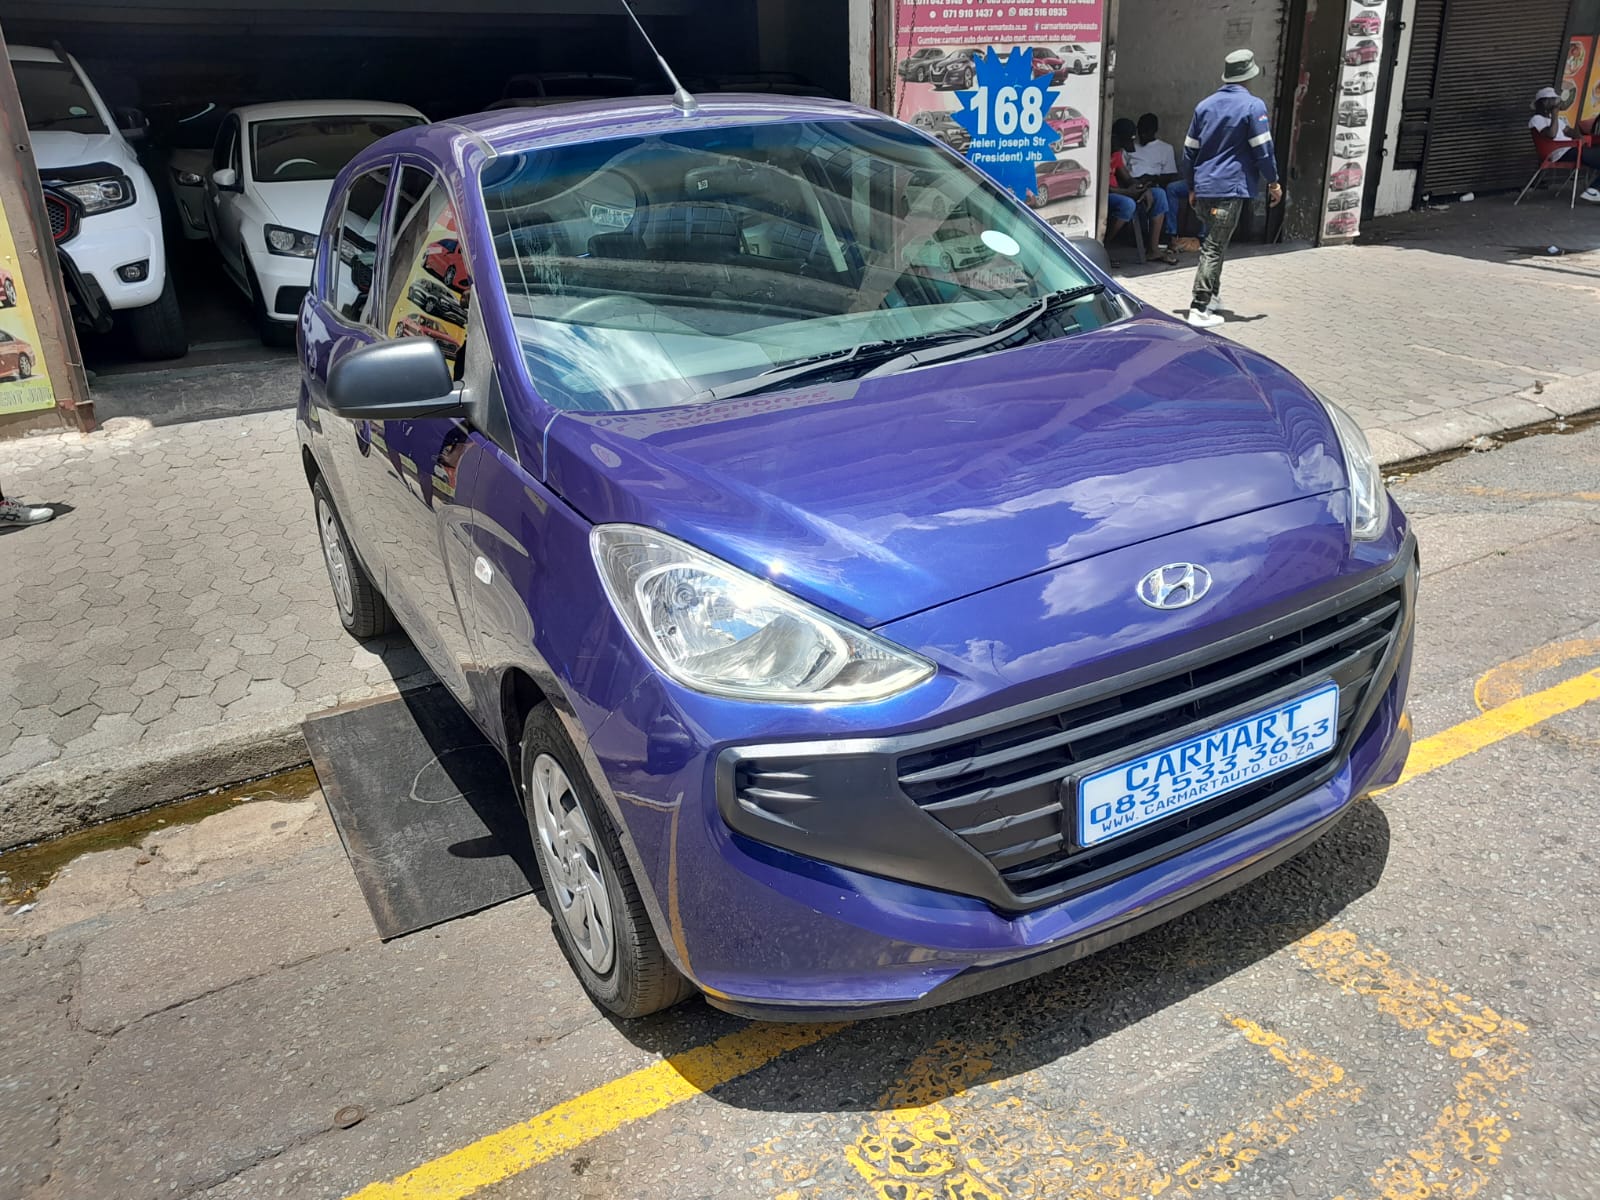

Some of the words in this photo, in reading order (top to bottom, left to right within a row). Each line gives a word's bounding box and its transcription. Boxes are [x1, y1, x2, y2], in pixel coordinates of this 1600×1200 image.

[943, 9, 957, 18] 071
[958, 9, 974, 18] 910
[975, 8, 994, 18] 1437
[1018, 8, 1033, 17] 083
[1034, 8, 1047, 16] 516
[1048, 8, 1068, 16] 0935
[970, 86, 1043, 135] 168
[970, 137, 996, 149] Helen
[998, 136, 1030, 150] joseph
[1032, 136, 1046, 146] Str
[971, 150, 1024, 163] (President)
[1026, 151, 1042, 161] Jhb
[1126, 704, 1302, 791] CARMART
[1090, 784, 1160, 825] 083
[1172, 754, 1238, 793] 533
[1249, 718, 1330, 763] 3653
